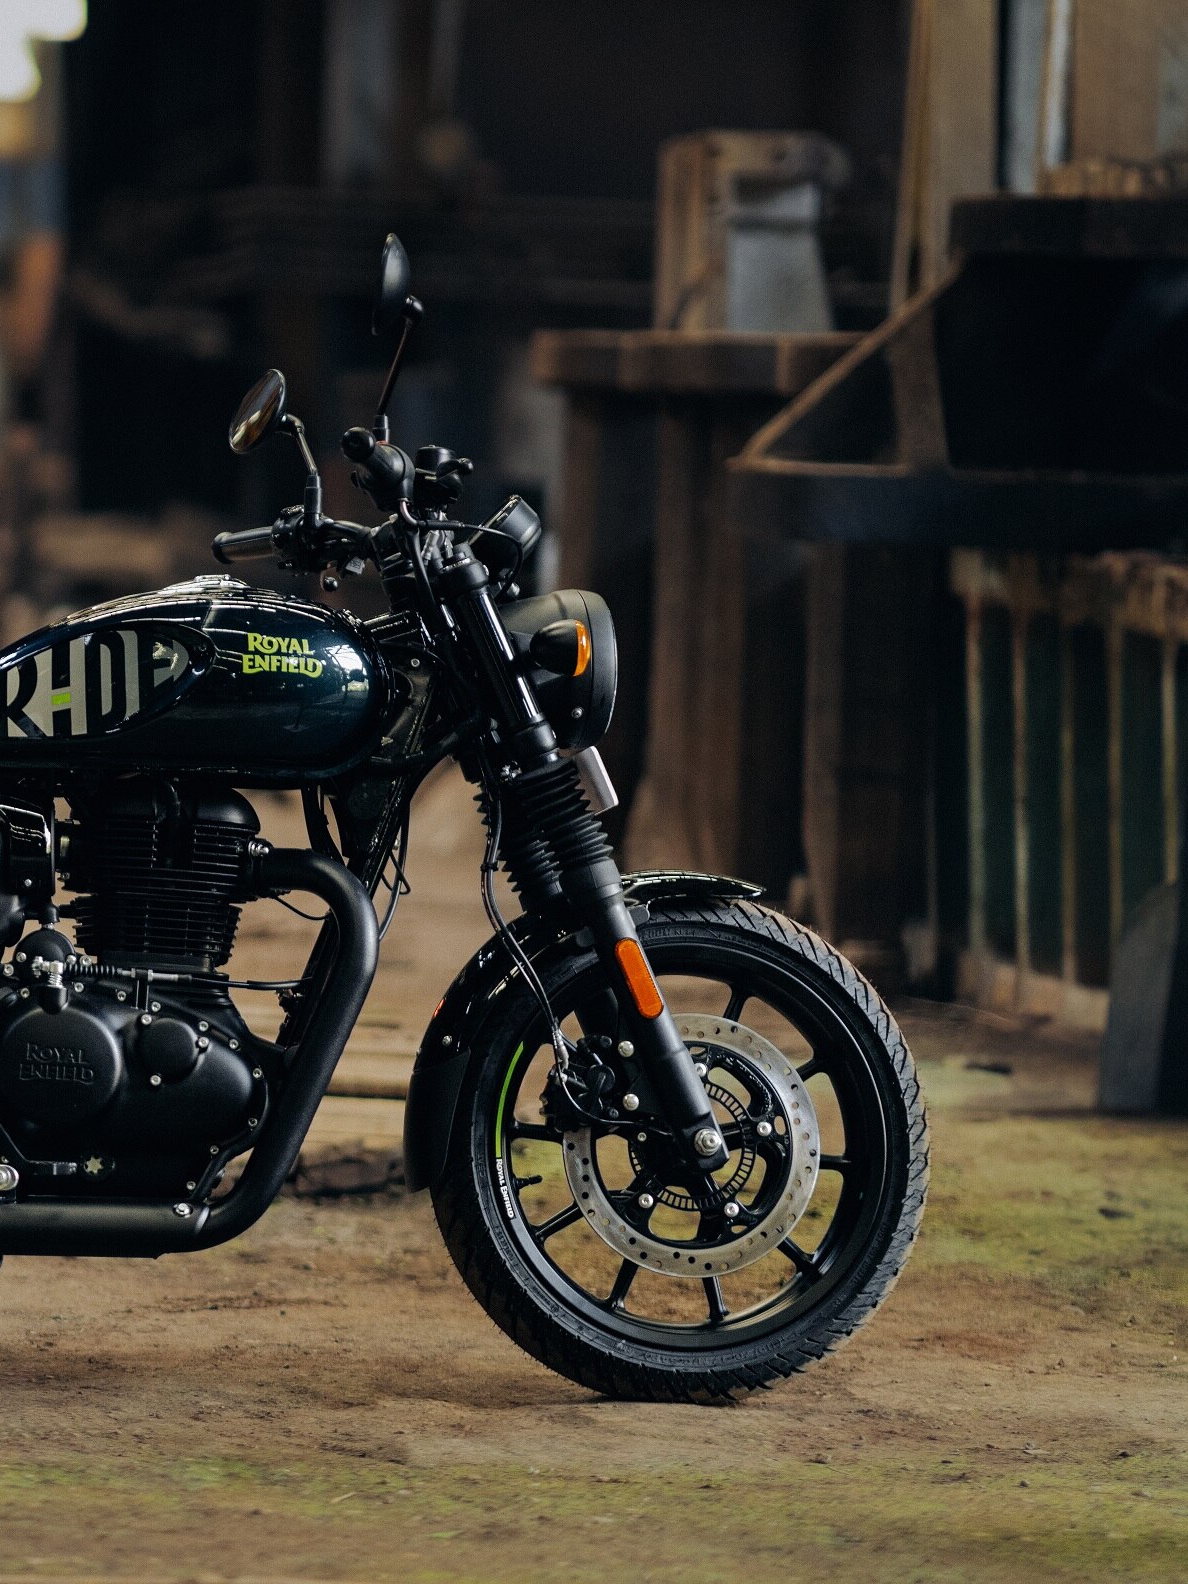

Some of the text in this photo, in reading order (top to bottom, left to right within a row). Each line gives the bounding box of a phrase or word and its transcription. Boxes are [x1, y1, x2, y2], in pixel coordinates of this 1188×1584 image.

[247, 632, 315, 655] ROYAL
[242, 654, 323, 678] ENFIELD
[26, 1042, 89, 1064] ROYAL
[496, 1159, 504, 1186] ROYAL
[501, 1187, 514, 1218] ENFIELD
